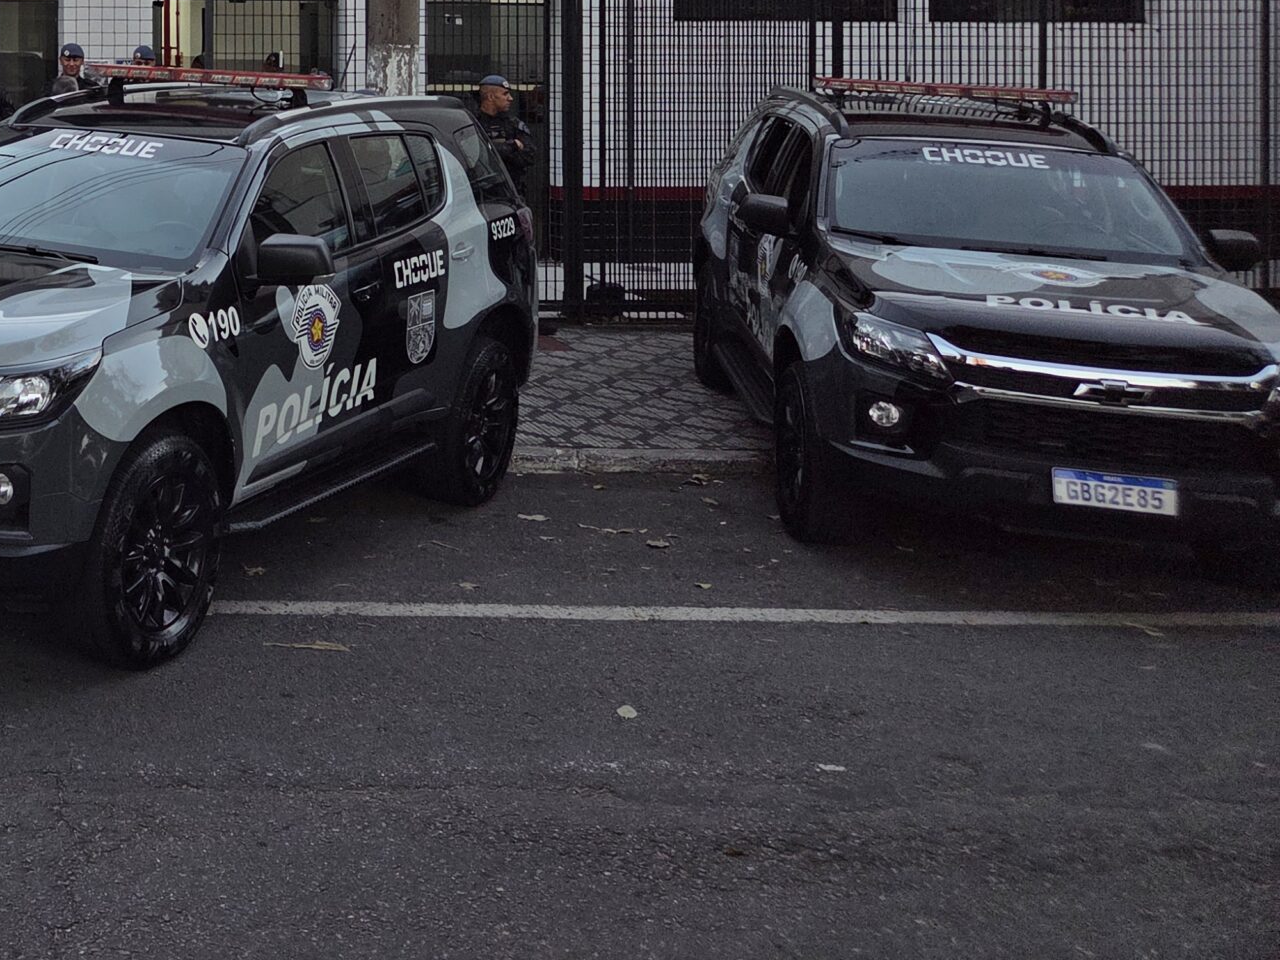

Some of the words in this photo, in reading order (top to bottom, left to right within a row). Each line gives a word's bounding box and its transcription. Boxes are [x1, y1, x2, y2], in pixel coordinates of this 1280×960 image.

[49, 133, 164, 158] CHOQUE
[922, 146, 1050, 169] CHOQUE
[491, 216, 515, 240] 93229
[393, 249, 446, 289] CHOQUE
[208, 306, 241, 342] 190
[986, 294, 1214, 326] POLÍCIA
[252, 357, 377, 458] POLÍCIA
[1065, 480, 1164, 511] GBG2E85
